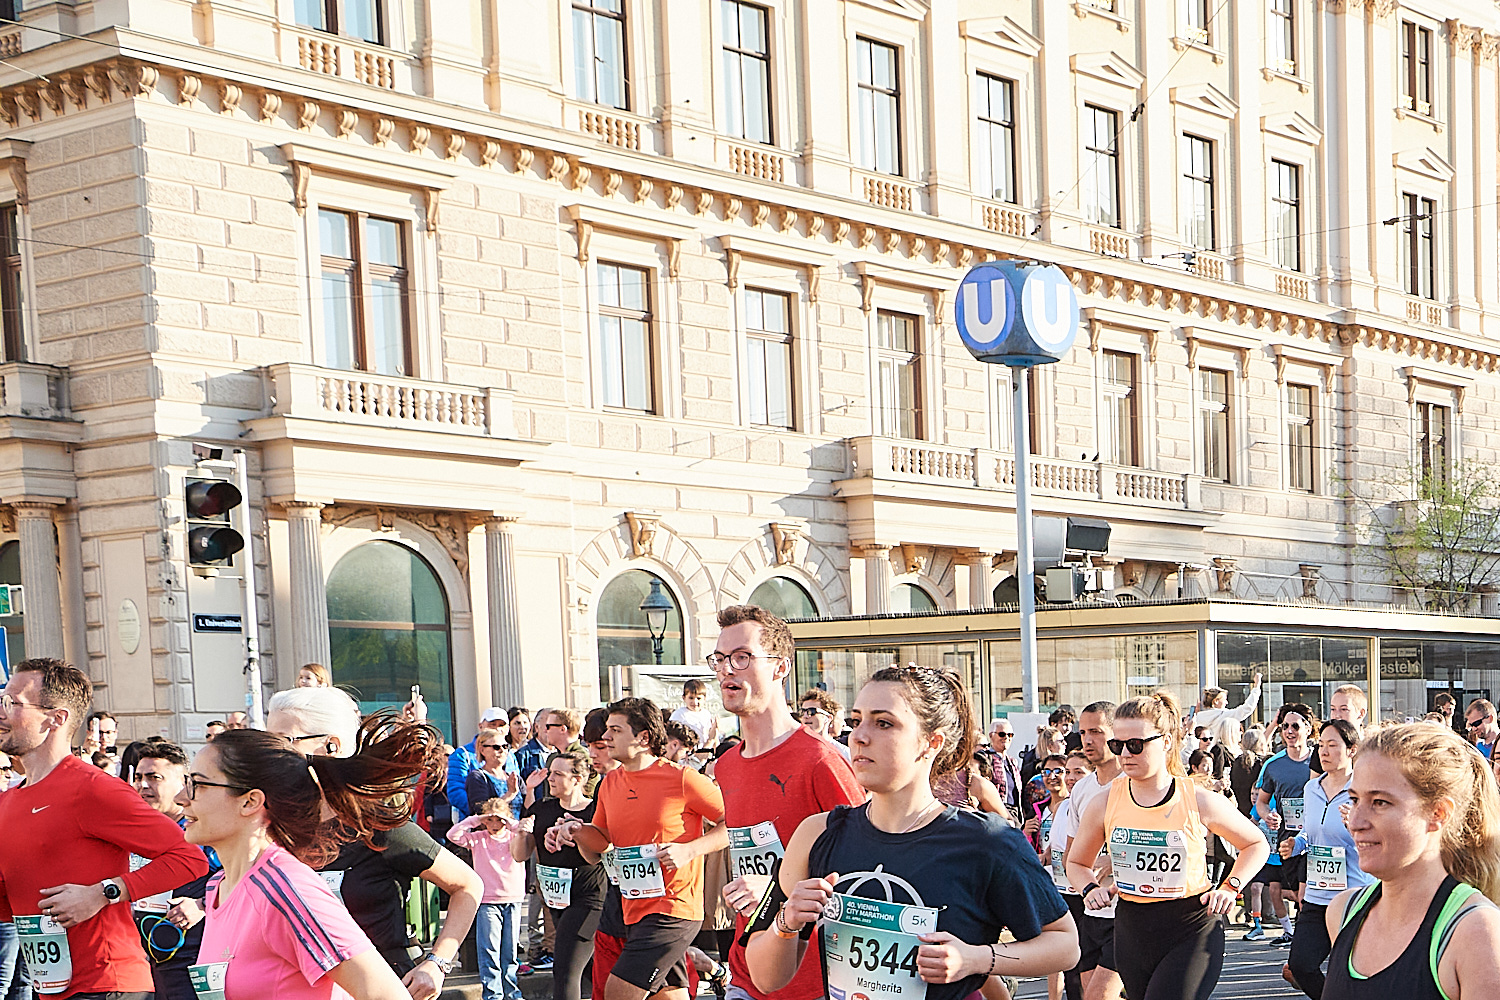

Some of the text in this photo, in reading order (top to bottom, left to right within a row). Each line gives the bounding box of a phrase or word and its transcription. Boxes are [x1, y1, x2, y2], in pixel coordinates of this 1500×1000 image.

[962, 278, 1006, 344] U
[1030, 278, 1071, 345] U
[1323, 660, 1366, 676] Mölker
[758, 830, 771, 838] 5K
[622, 861, 657, 879] 6794
[1136, 852, 1181, 872] 5262
[1316, 860, 1342, 874] 5737
[544, 880, 567, 894] 5401
[1152, 875, 1164, 883] Lini
[846, 908, 895, 922] CITY MARATHON
[857, 902, 880, 912] VIENNA
[911, 915, 927, 927] 5K
[23, 940, 61, 965] 6159
[848, 935, 920, 978] 5344
[856, 977, 902, 994] Margherita
